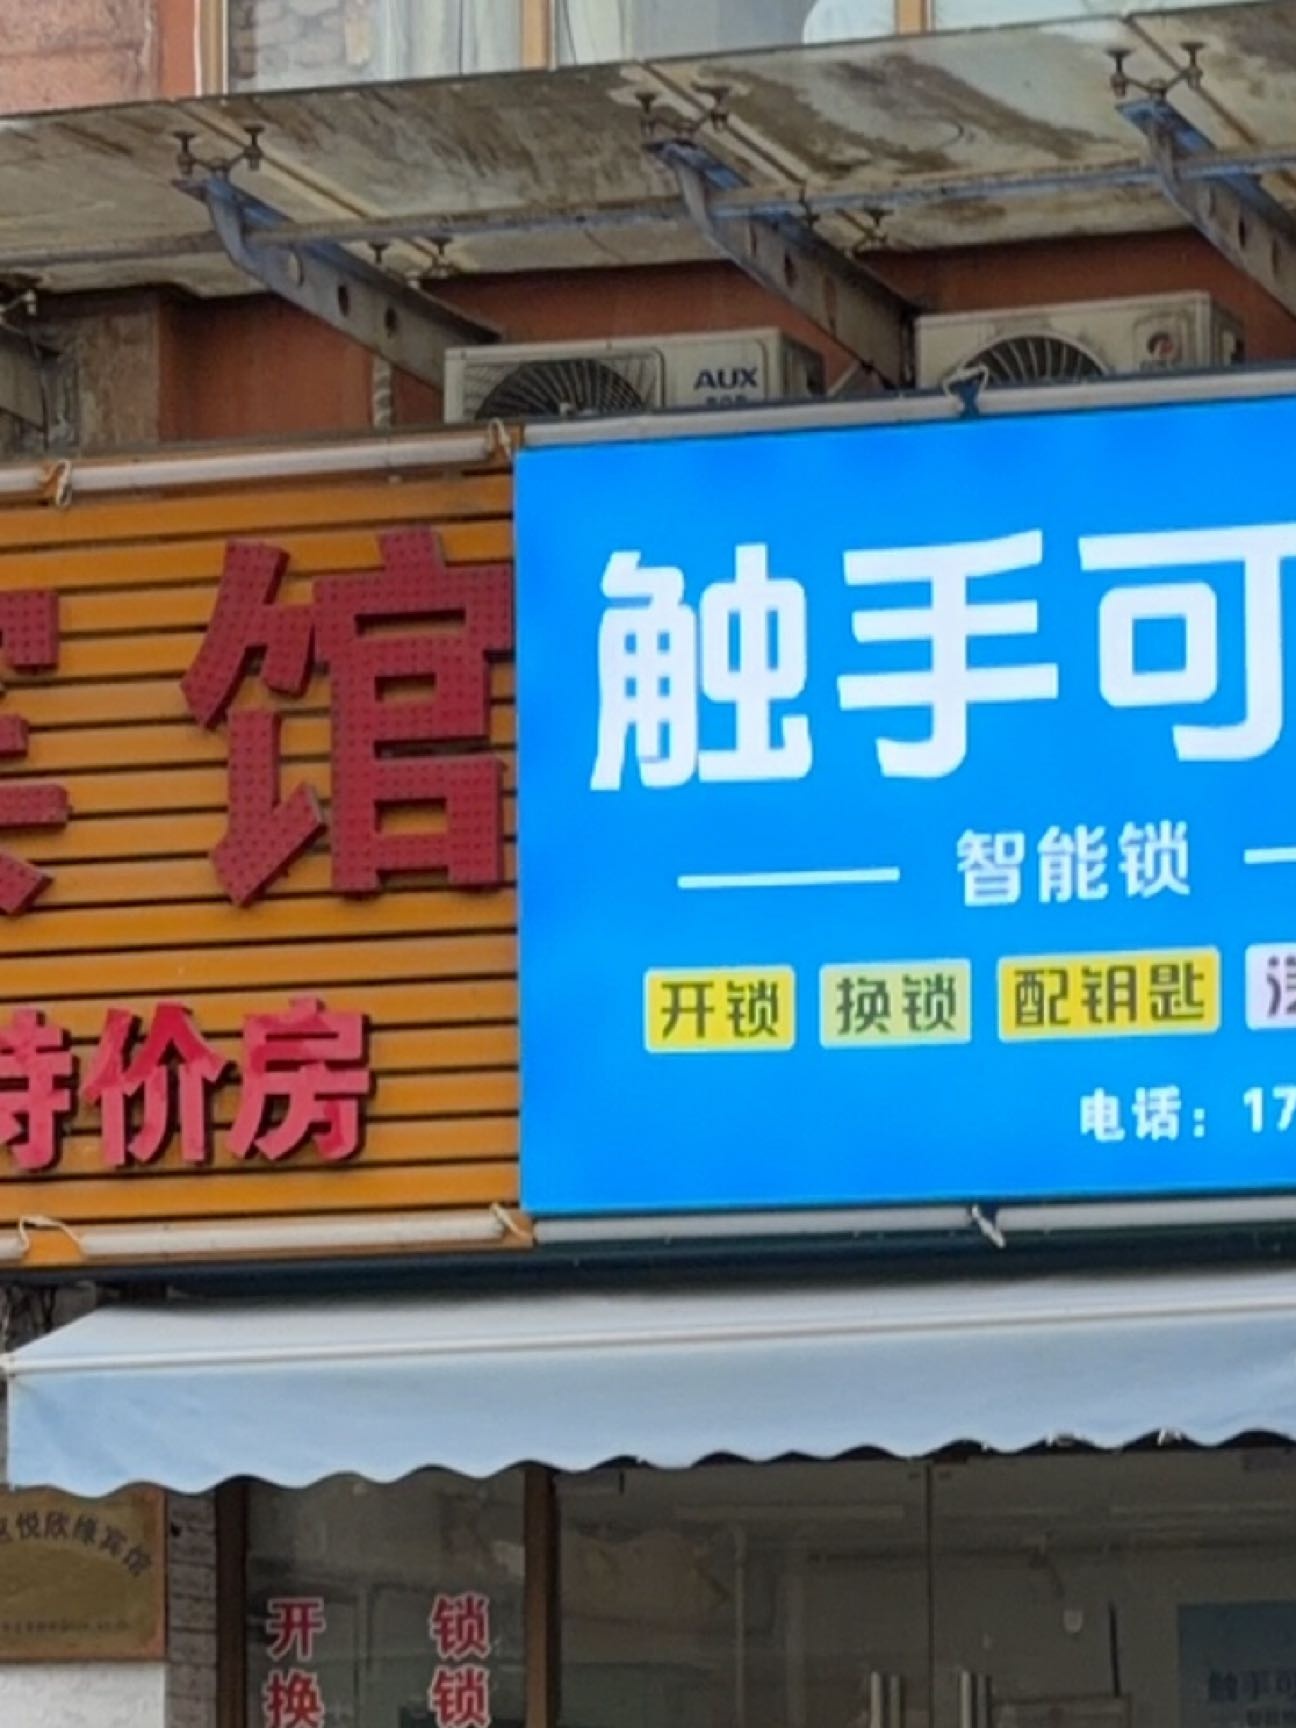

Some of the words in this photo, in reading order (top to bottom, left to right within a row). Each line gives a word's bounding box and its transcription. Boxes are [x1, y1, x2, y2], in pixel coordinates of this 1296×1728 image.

[693, 366, 758, 390] AUX
[955, 821, 1192, 907] 智能锁
[658, 978, 782, 1039] 开锁
[835, 969, 958, 1036] 换锁
[1013, 963, 1206, 1028] 配钥匙
